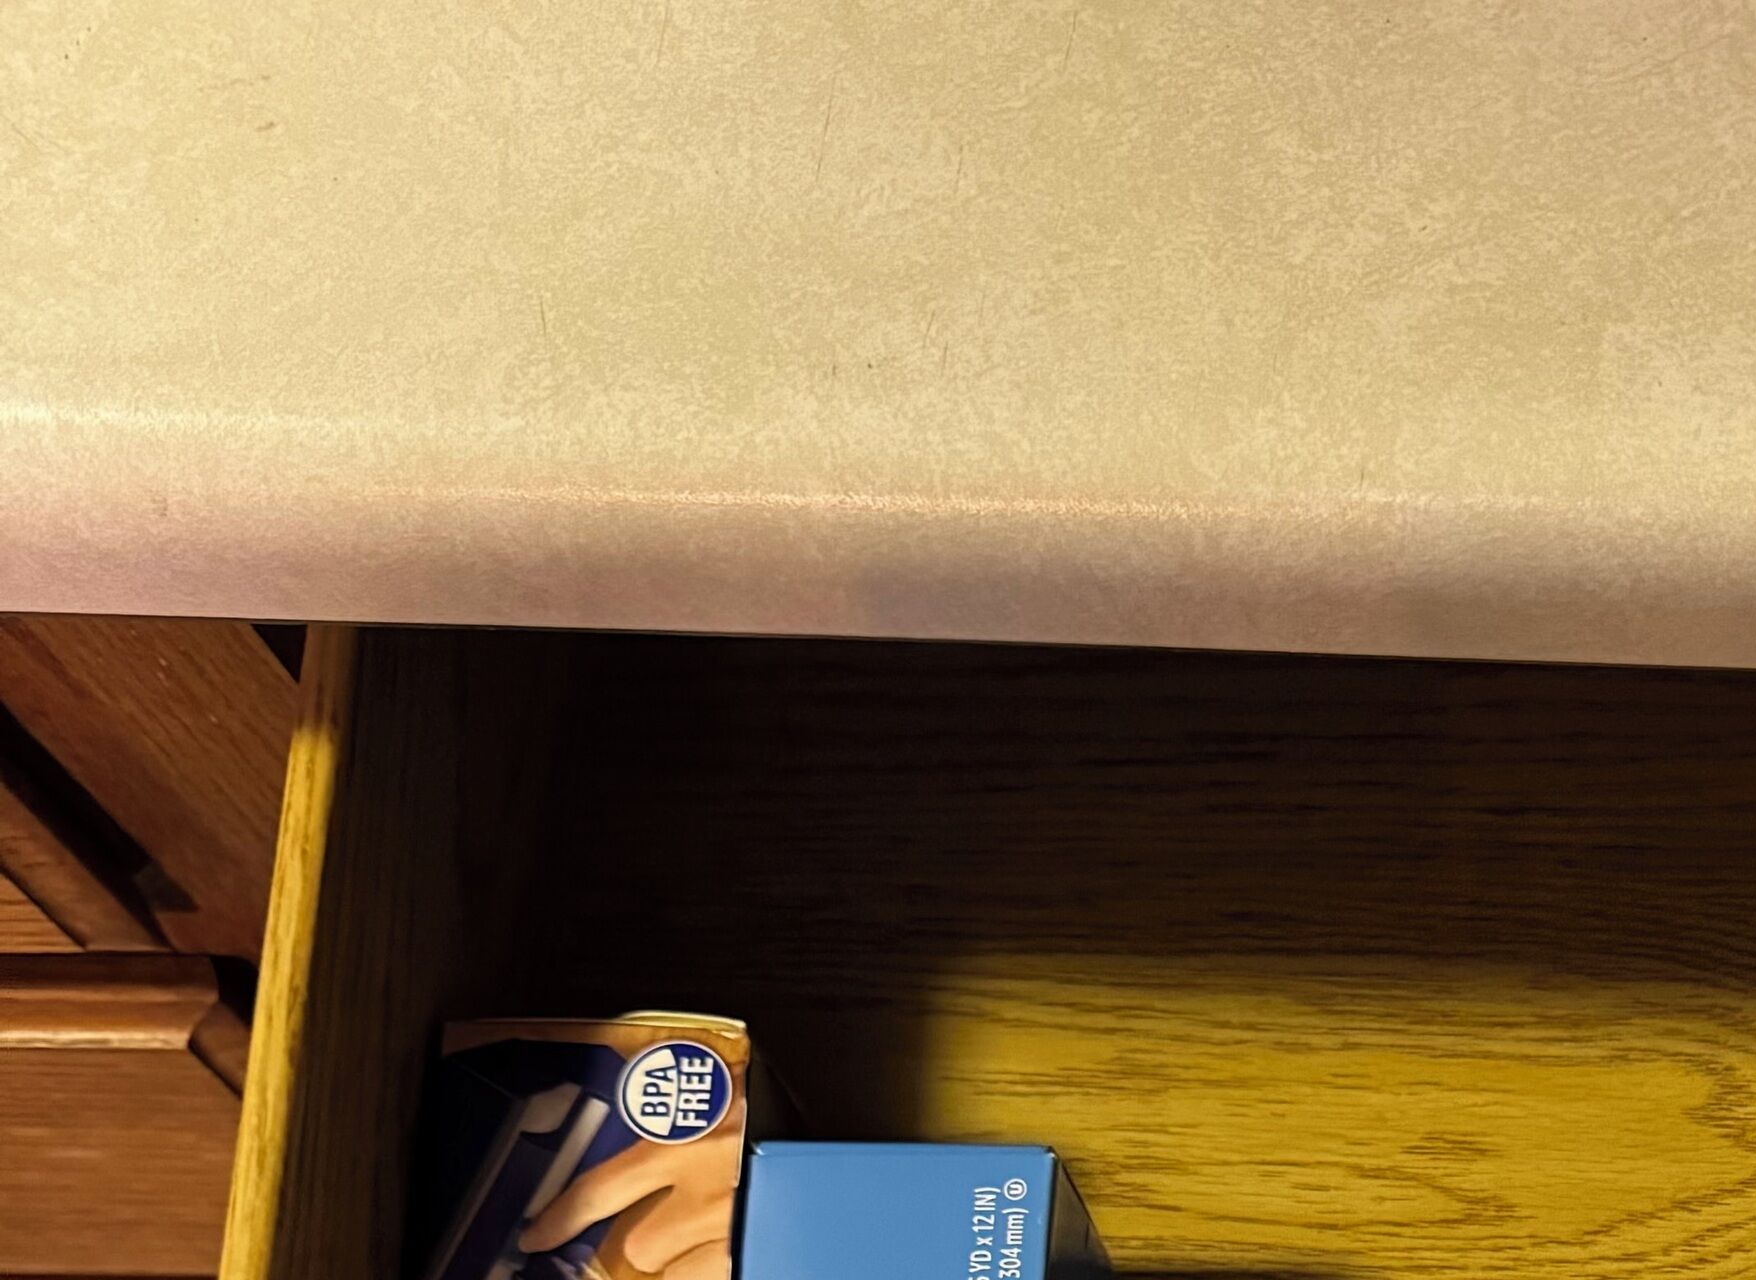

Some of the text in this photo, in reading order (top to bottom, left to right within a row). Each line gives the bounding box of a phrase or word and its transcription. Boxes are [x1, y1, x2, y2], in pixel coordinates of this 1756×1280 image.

[641, 1066, 676, 1118] BPA
[678, 1056, 714, 1128] FREE
[974, 1186, 1001, 1210] IN)
[972, 1213, 995, 1233] 12
[1002, 1207, 1029, 1248] mm)
[969, 1251, 991, 1273] YD
[999, 1249, 1021, 1279] 304
